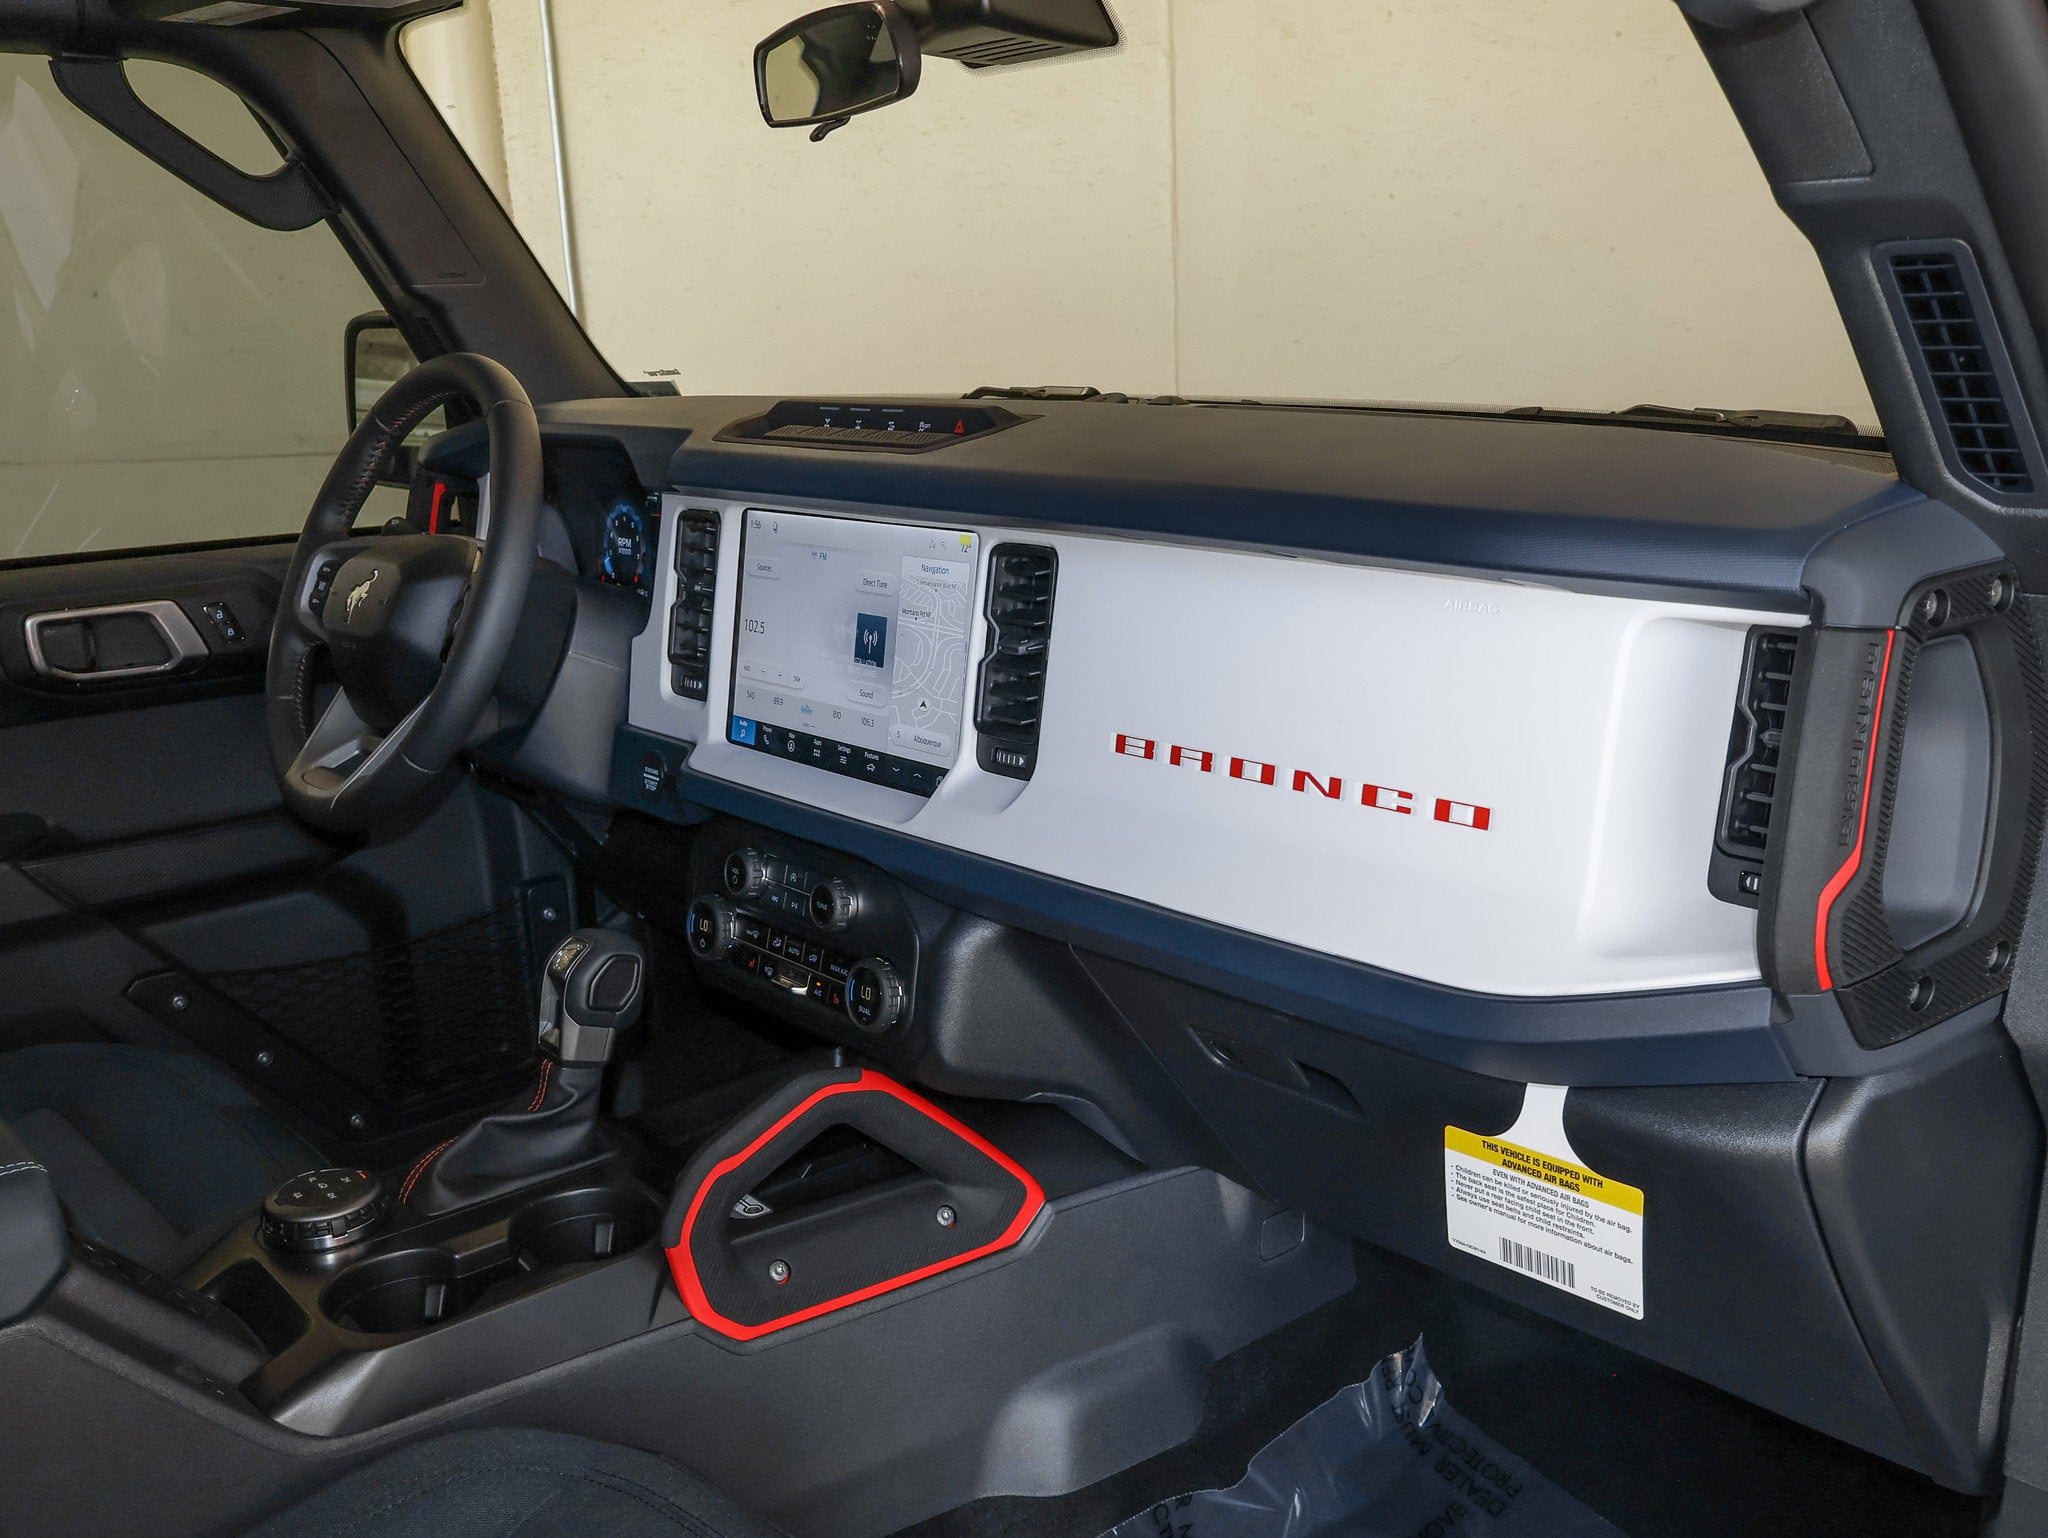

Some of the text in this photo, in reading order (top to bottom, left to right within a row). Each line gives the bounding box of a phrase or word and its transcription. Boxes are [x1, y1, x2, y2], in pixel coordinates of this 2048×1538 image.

[617, 537, 632, 547] RPM
[862, 577, 876, 588] Direct
[920, 563, 950, 575] Navigation
[1443, 599, 1500, 615] AIRBAG
[744, 618, 765, 634] 102.5
[859, 689, 874, 699] Sound
[1111, 731, 1492, 832] BRONCO
[788, 946, 800, 956] AUTO
[1481, 1139, 1603, 1188] THIS VEHICLE IS EQUIPPED WITH
[1502, 1158, 1580, 1192] ADVANCED AIR BAGS
[1455, 1164, 1481, 1178] Children
[1482, 1174, 1494, 1183] can
[1494, 1177, 1503, 1187] be
[1503, 1180, 1521, 1192] killed
[1530, 1192, 1560, 1207] seriously
[1560, 1201, 1584, 1215] injured
[1584, 1211, 1594, 1220] by
[1594, 1214, 1606, 1223] the
[1606, 1219, 1616, 1227] air
[1617, 1222, 1633, 1234] bag.
[1455, 1171, 1468, 1182] The
[1468, 1175, 1483, 1187] back
[1484, 1182, 1498, 1192] seat
[1505, 1189, 1516, 1199] the
[1516, 1193, 1536, 1206] safest
[1536, 1202, 1556, 1213] place
[1555, 1208, 1565, 1216] for
[1566, 1211, 1596, 1228] Children.
[1455, 1179, 1474, 1190] Never
[1474, 1186, 1485, 1195] put
[1490, 1192, 1504, 1202] rear
[1504, 1196, 1525, 1211] facing
[1525, 1204, 1541, 1215] child
[1542, 1211, 1556, 1221] seat
[1564, 1218, 1576, 1227] the
[1492, 1168, 1590, 1209] EVEN WITH ADVANCED AIR BAGS
[1455, 1187, 1479, 1201] Always
[1478, 1195, 1491, 1204] use
[1491, 1200, 1505, 1209] seat
[1505, 1204, 1522, 1216] belts
[1522, 1211, 1535, 1221] and
[1535, 1216, 1552, 1226] child
[1456, 1193, 1634, 1265] See owner's manual for more information about air bags.
[1596, 1294, 1640, 1315] CUSTOMER ONLY
[1606, 1292, 1632, 1306] REMOVED
[1433, 1456, 1508, 1518] DEALER
